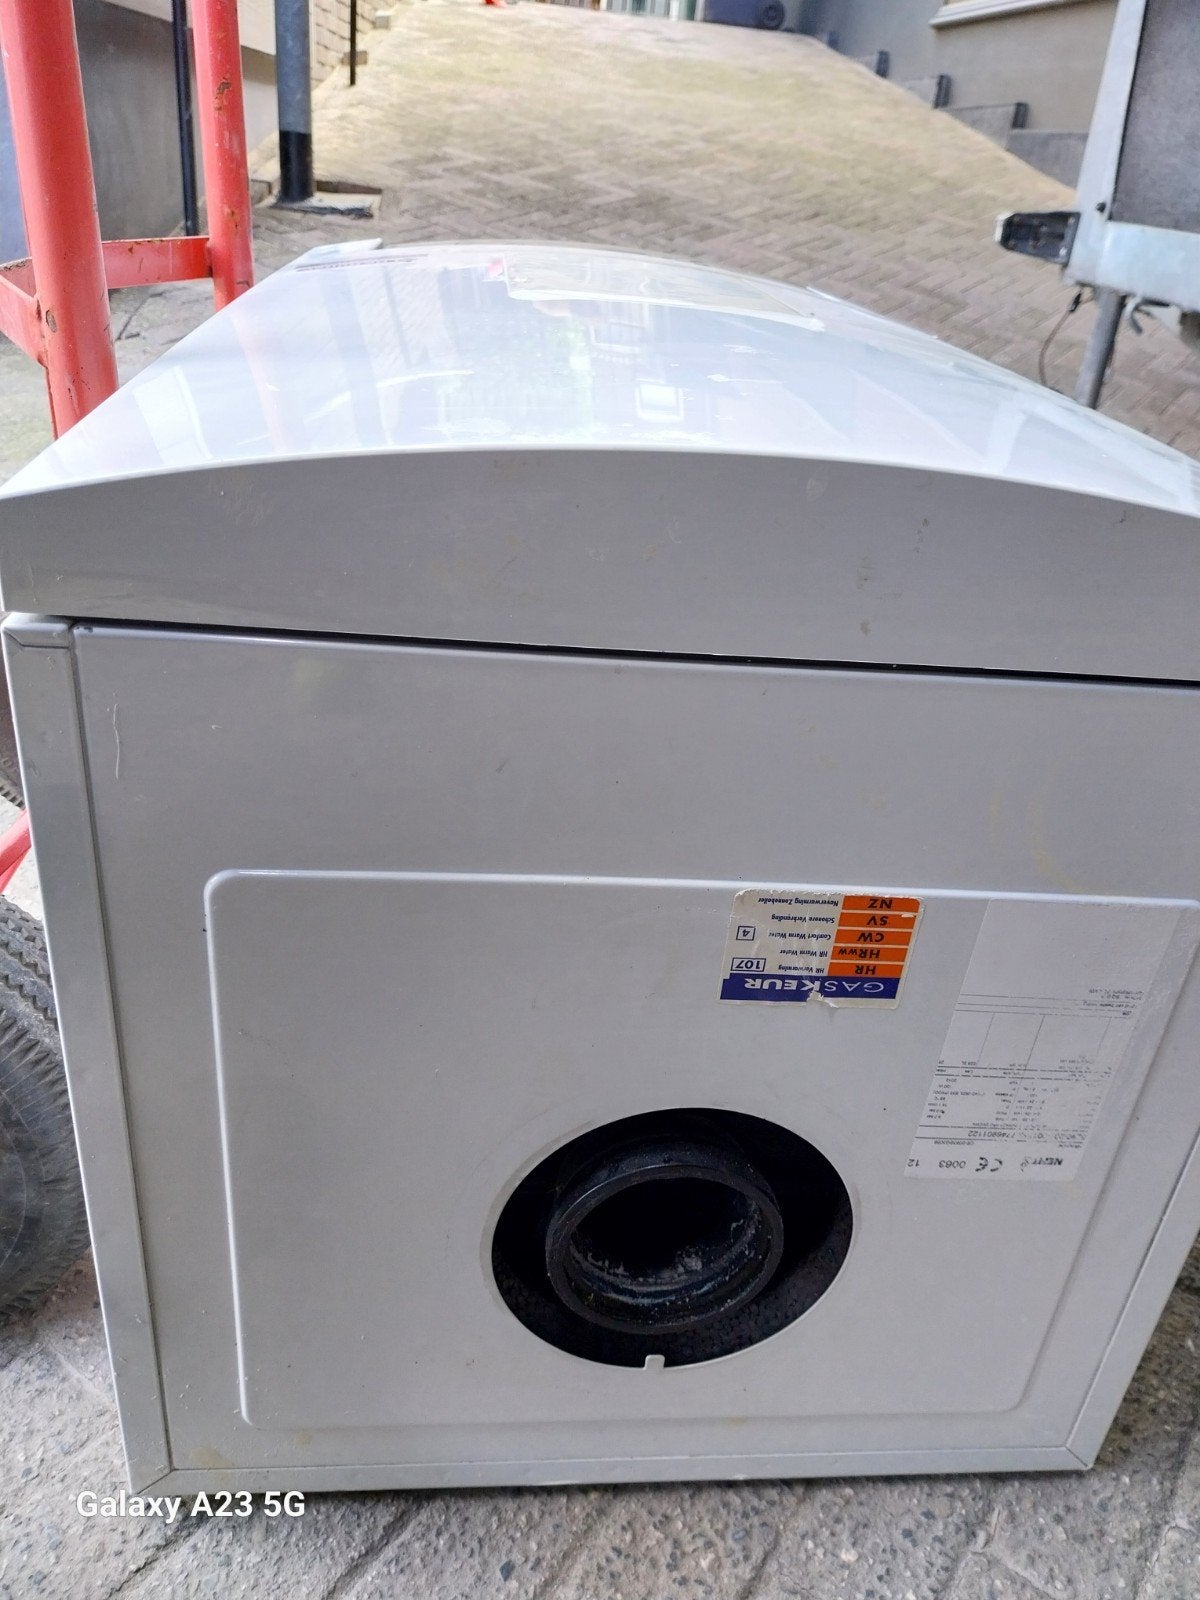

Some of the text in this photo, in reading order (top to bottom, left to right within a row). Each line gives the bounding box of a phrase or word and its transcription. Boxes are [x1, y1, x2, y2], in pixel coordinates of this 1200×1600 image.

[868, 898, 893, 909] NZ
[866, 915, 888, 925] SV
[808, 932, 831, 940] Comfort
[856, 932, 884, 941] CW
[736, 960, 761, 969] 107
[855, 965, 876, 975] HR
[744, 979, 884, 992] GASKEUR
[908, 1159, 920, 1167] 12
[939, 1160, 966, 1168] 0063
